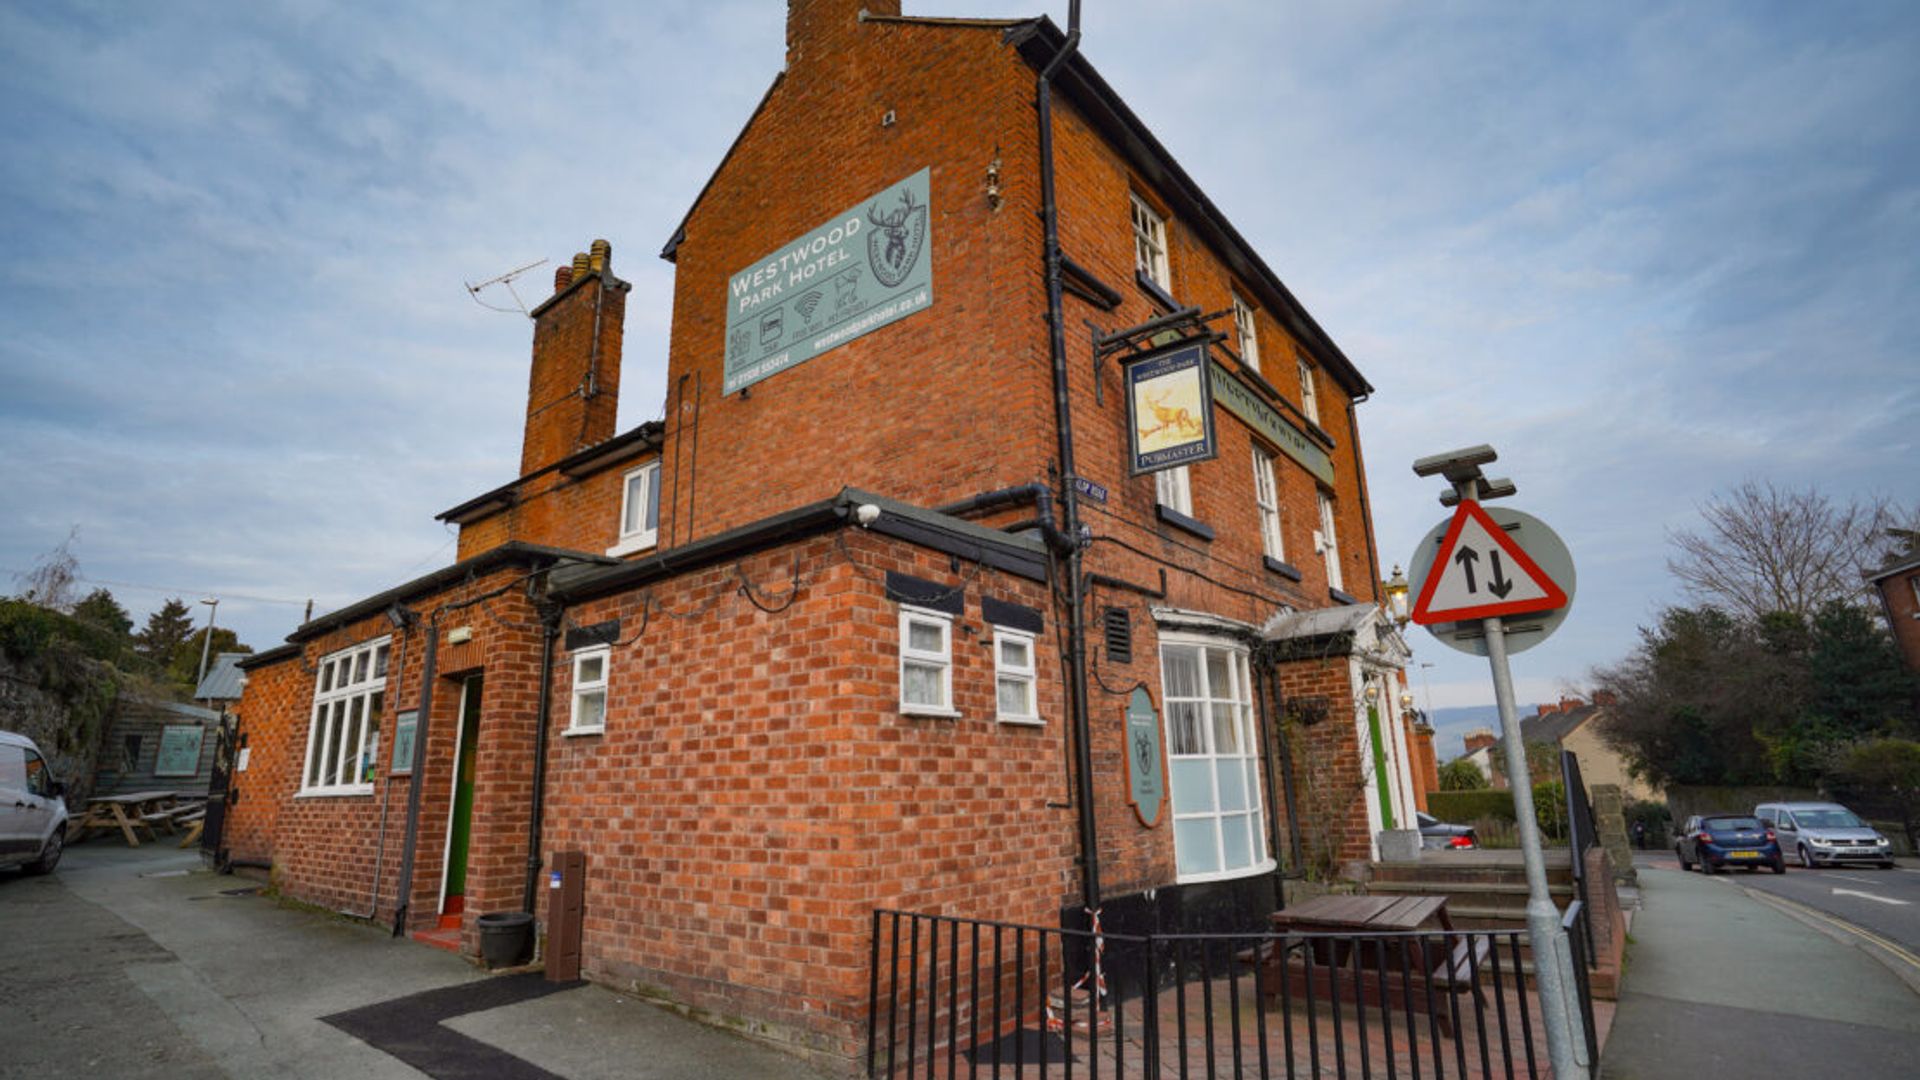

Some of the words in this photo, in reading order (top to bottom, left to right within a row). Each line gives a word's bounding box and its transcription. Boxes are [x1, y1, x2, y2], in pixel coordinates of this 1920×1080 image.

[732, 217, 861, 297] WESTWOOD
[740, 279, 783, 314] PARK
[789, 248, 850, 287] HOTEL
[1141, 443, 1205, 467] PUBMASTER
